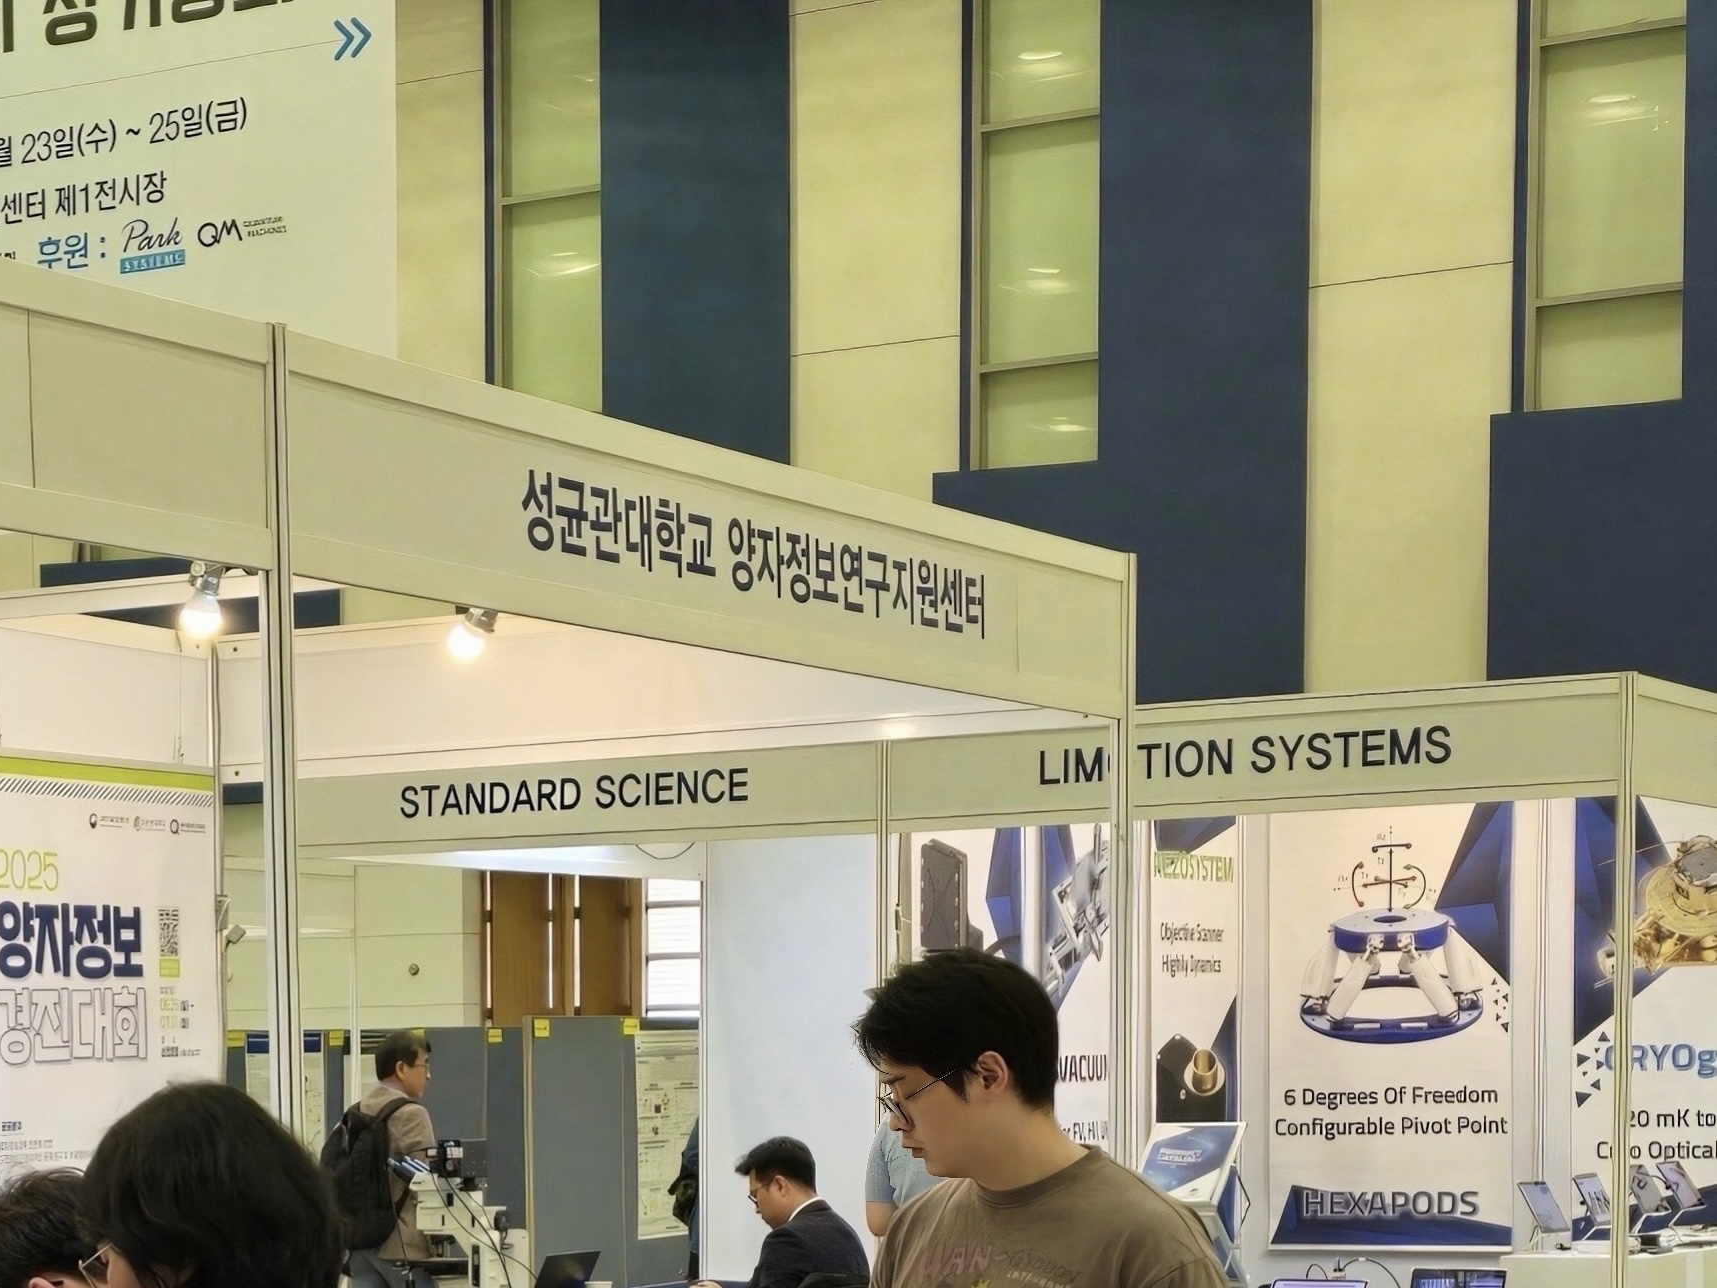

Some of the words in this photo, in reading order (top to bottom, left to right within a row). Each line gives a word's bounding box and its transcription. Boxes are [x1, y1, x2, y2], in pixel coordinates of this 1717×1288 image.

[20, 118, 117, 165] 23일(수)
[148, 96, 248, 146] 25일(금)
[54, 170, 168, 220] 제1전시장
[37, 231, 89, 269] 후원
[121, 216, 183, 253] Park
[197, 219, 243, 248] QM
[521, 469, 716, 578] 성균관대학교
[728, 517, 985, 639] 양자정보연구지원센터
[1038, 738, 1234, 786] LIMTION
[1250, 725, 1453, 773] SYSTEMS
[399, 777, 581, 819] STANDARD
[595, 767, 749, 809] SCIENCE
[1283, 1088, 1296, 1106] 6
[1302, 1087, 1378, 1110] Degrees
[1384, 1086, 1407, 1105] Of
[1412, 1085, 1499, 1104] Freedom
[1275, 1116, 1395, 1141] Configurable
[1401, 1116, 1452, 1135] Pivot
[1457, 1115, 1509, 1134] Point
[1656, 1108, 1690, 1128] mK
[1597, 1141, 1641, 1159] Co
[1302, 1189, 1481, 1218] HEXAPODS
